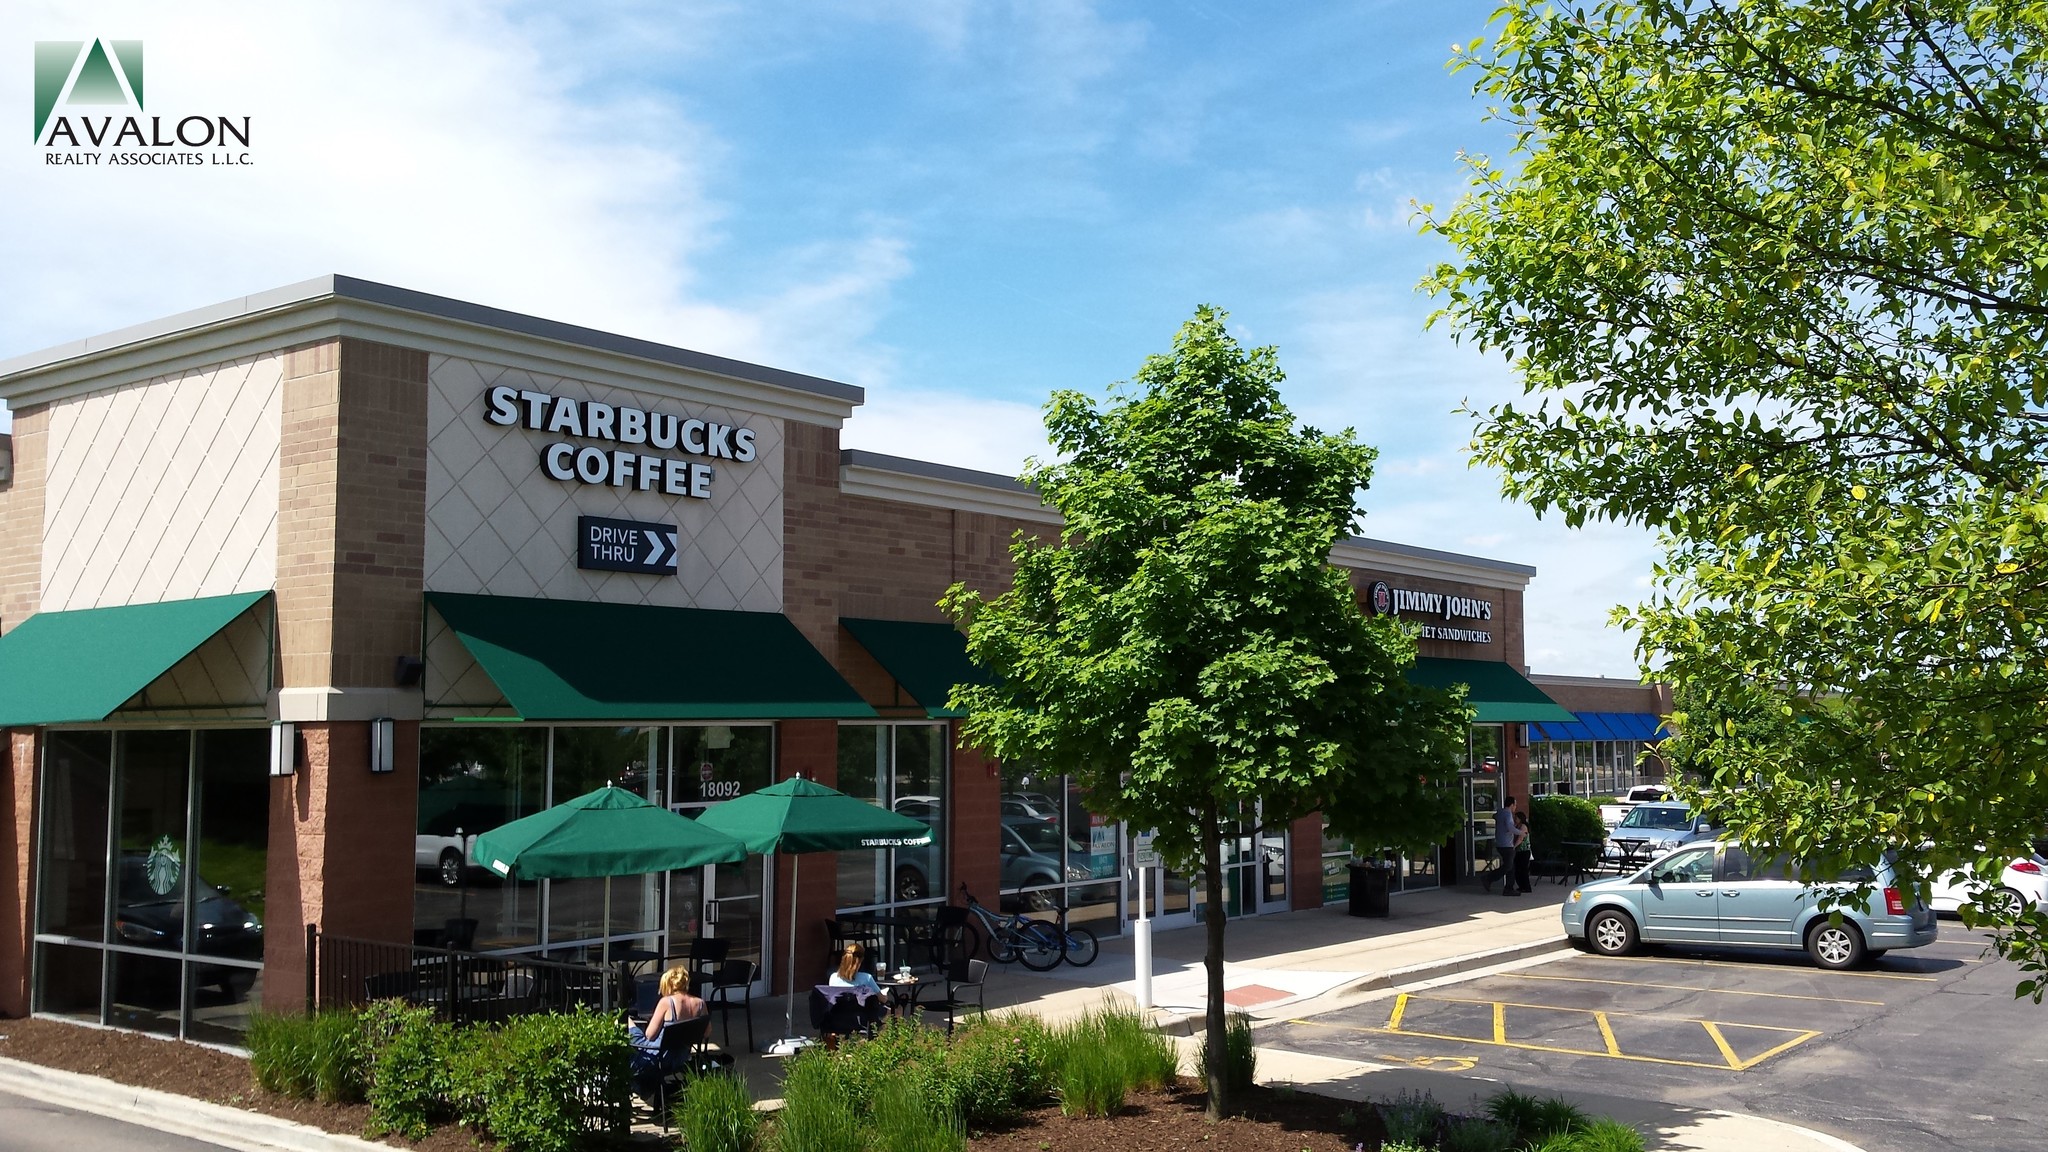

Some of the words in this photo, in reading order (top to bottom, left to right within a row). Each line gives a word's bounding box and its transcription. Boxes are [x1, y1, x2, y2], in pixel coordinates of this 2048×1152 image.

[485, 386, 757, 463] STARBUCKS
[542, 442, 712, 499] COFFEE
[590, 525, 638, 546] DRIVE
[590, 544, 635, 563] THRU
[1393, 589, 1442, 615] JIMMY
[1445, 595, 1492, 621] JOHN'S
[1437, 626, 1492, 644] SANDWICHES
[700, 780, 741, 798] 18092
[860, 837, 903, 847] STARBUCKS
